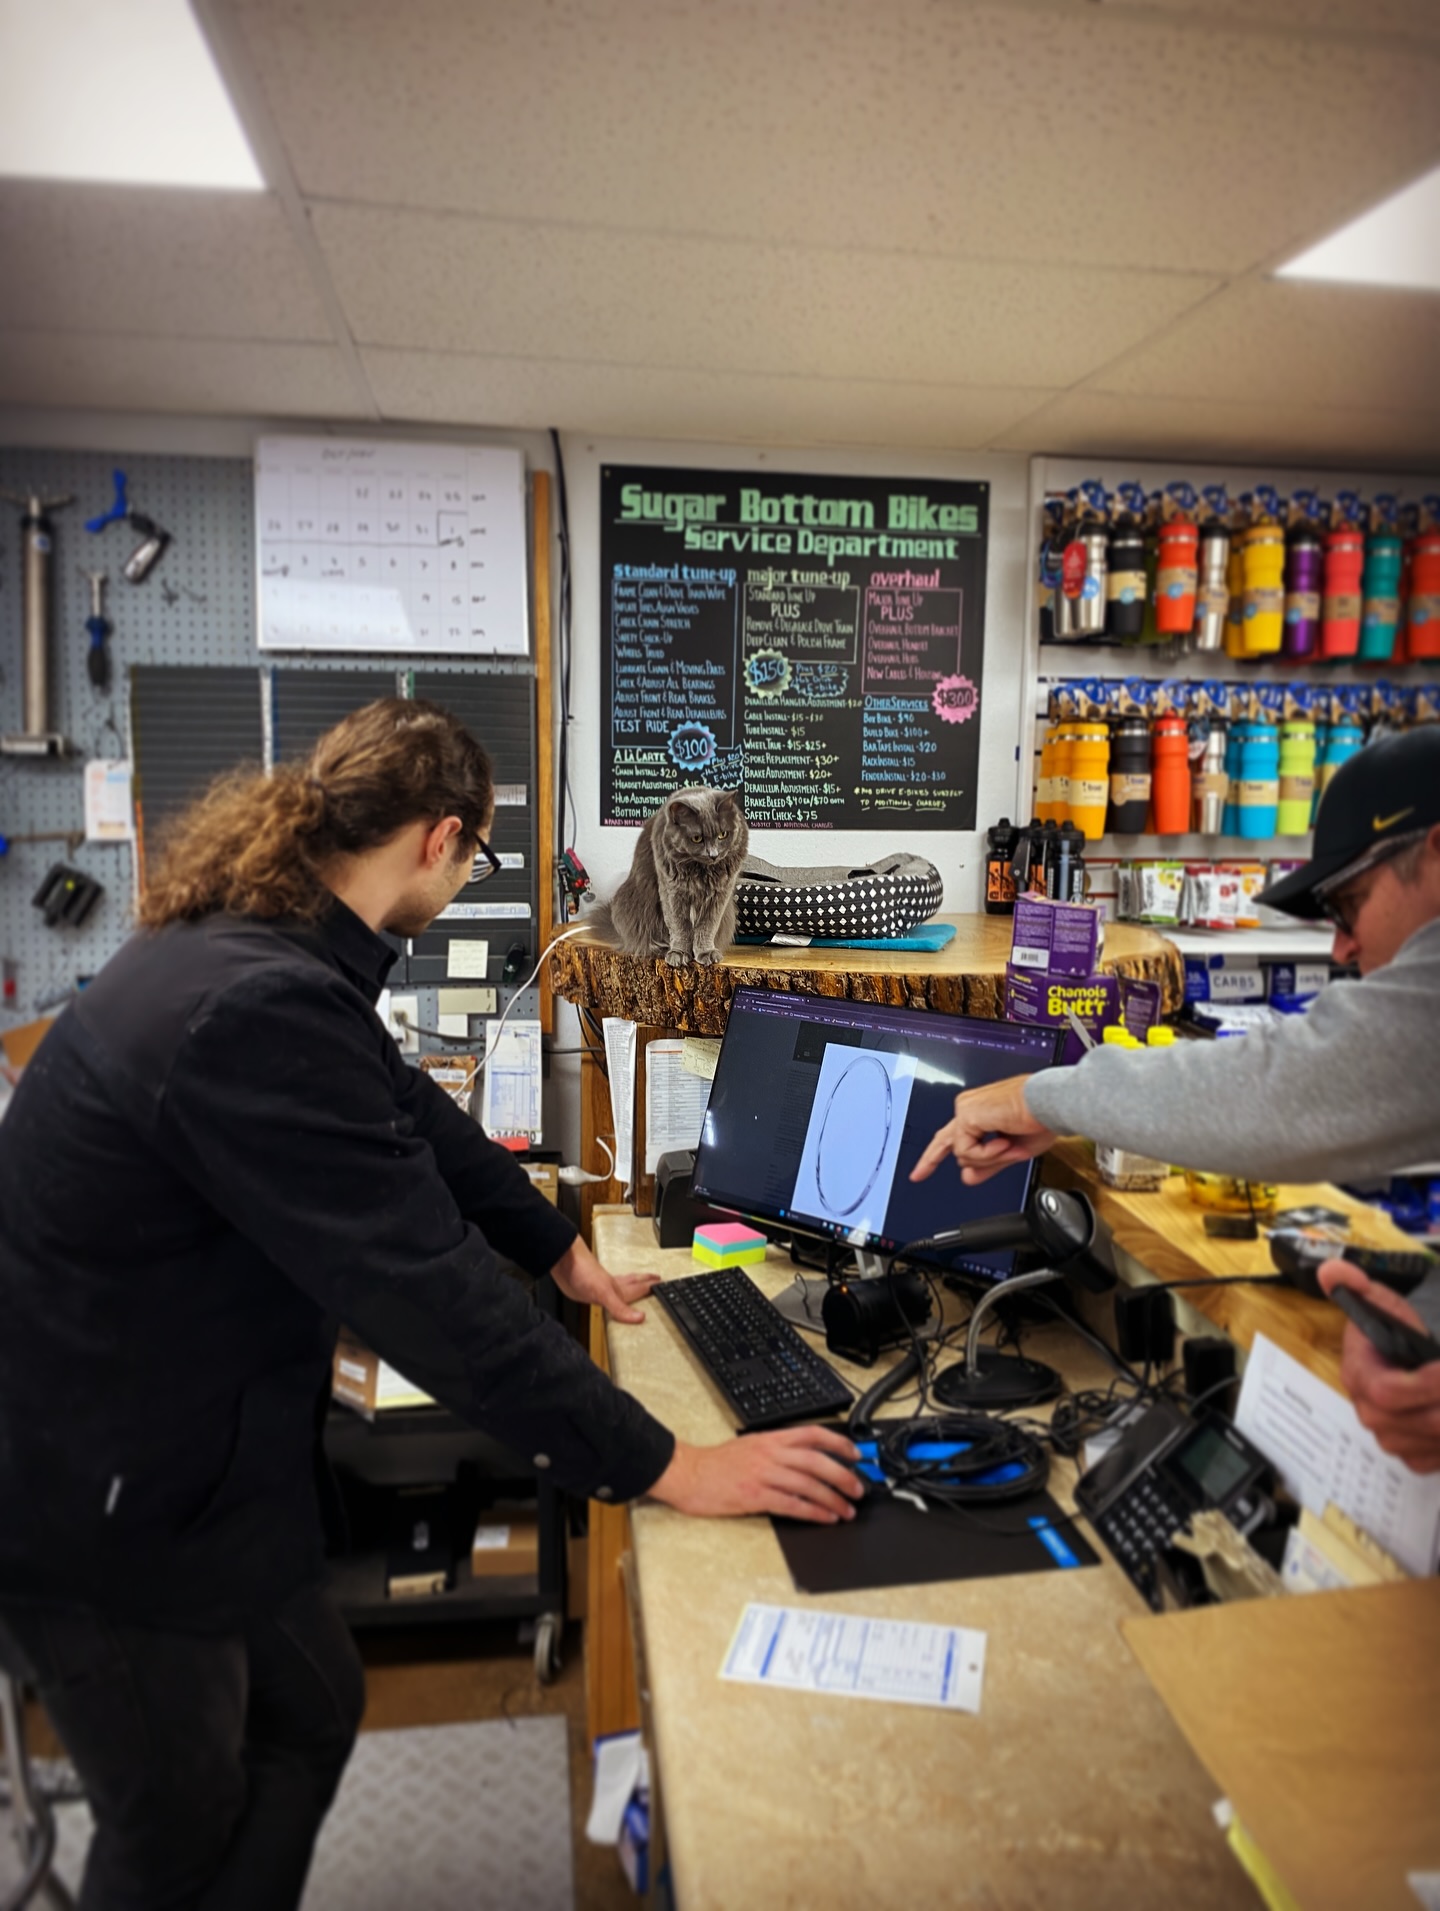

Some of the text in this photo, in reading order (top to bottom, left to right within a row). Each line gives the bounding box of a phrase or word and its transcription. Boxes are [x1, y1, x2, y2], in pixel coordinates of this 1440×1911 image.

[621, 484, 978, 532] Sugar Bottom Bikes
[684, 525, 959, 567] Service Department
[614, 563, 736, 587] standard tune-up
[747, 566, 850, 591] major tune-up
[870, 568, 940, 587] overhaul
[771, 603, 800, 618] PLUS
[881, 606, 914, 621] PLUS
[749, 659, 786, 686] $150
[864, 695, 929, 710] OTHER SERVICES
[939, 689, 972, 708] $300
[744, 710, 763, 721] CABLE
[614, 720, 669, 733] TEST RIDE
[744, 723, 760, 735] TUBE
[790, 725, 805, 737] $15
[863, 726, 883, 737] BUILD
[675, 738, 708, 760] $100
[743, 738, 767, 749] WHEEL
[863, 740, 877, 752] BAR
[877, 740, 892, 752] TAPE
[919, 741, 937, 753] $20
[614, 748, 666, 761] A CARTE
[744, 752, 766, 764] SPOKE
[815, 754, 839, 768] $30+
[862, 754, 915, 767] RACK $15
[615, 765, 634, 776] CHAIN
[660, 767, 677, 779] $20
[744, 766, 766, 778] BRAKE
[809, 769, 832, 779] $20+
[861, 769, 884, 781] FENDER
[615, 779, 641, 789] HEADSET
[744, 781, 779, 793] DERAILLEUR
[823, 782, 841, 795] $15+
[615, 792, 629, 804] HUB
[744, 795, 767, 807] BRAKE
[767, 795, 785, 808] BLEED
[615, 806, 640, 817] BOTTOM
[744, 808, 770, 820] SAFETY
[797, 809, 817, 822] $75
[1213, 975, 1255, 989] CARBS
[1048, 984, 1107, 998] Chamois
[1048, 997, 1106, 1016] Butt'r
